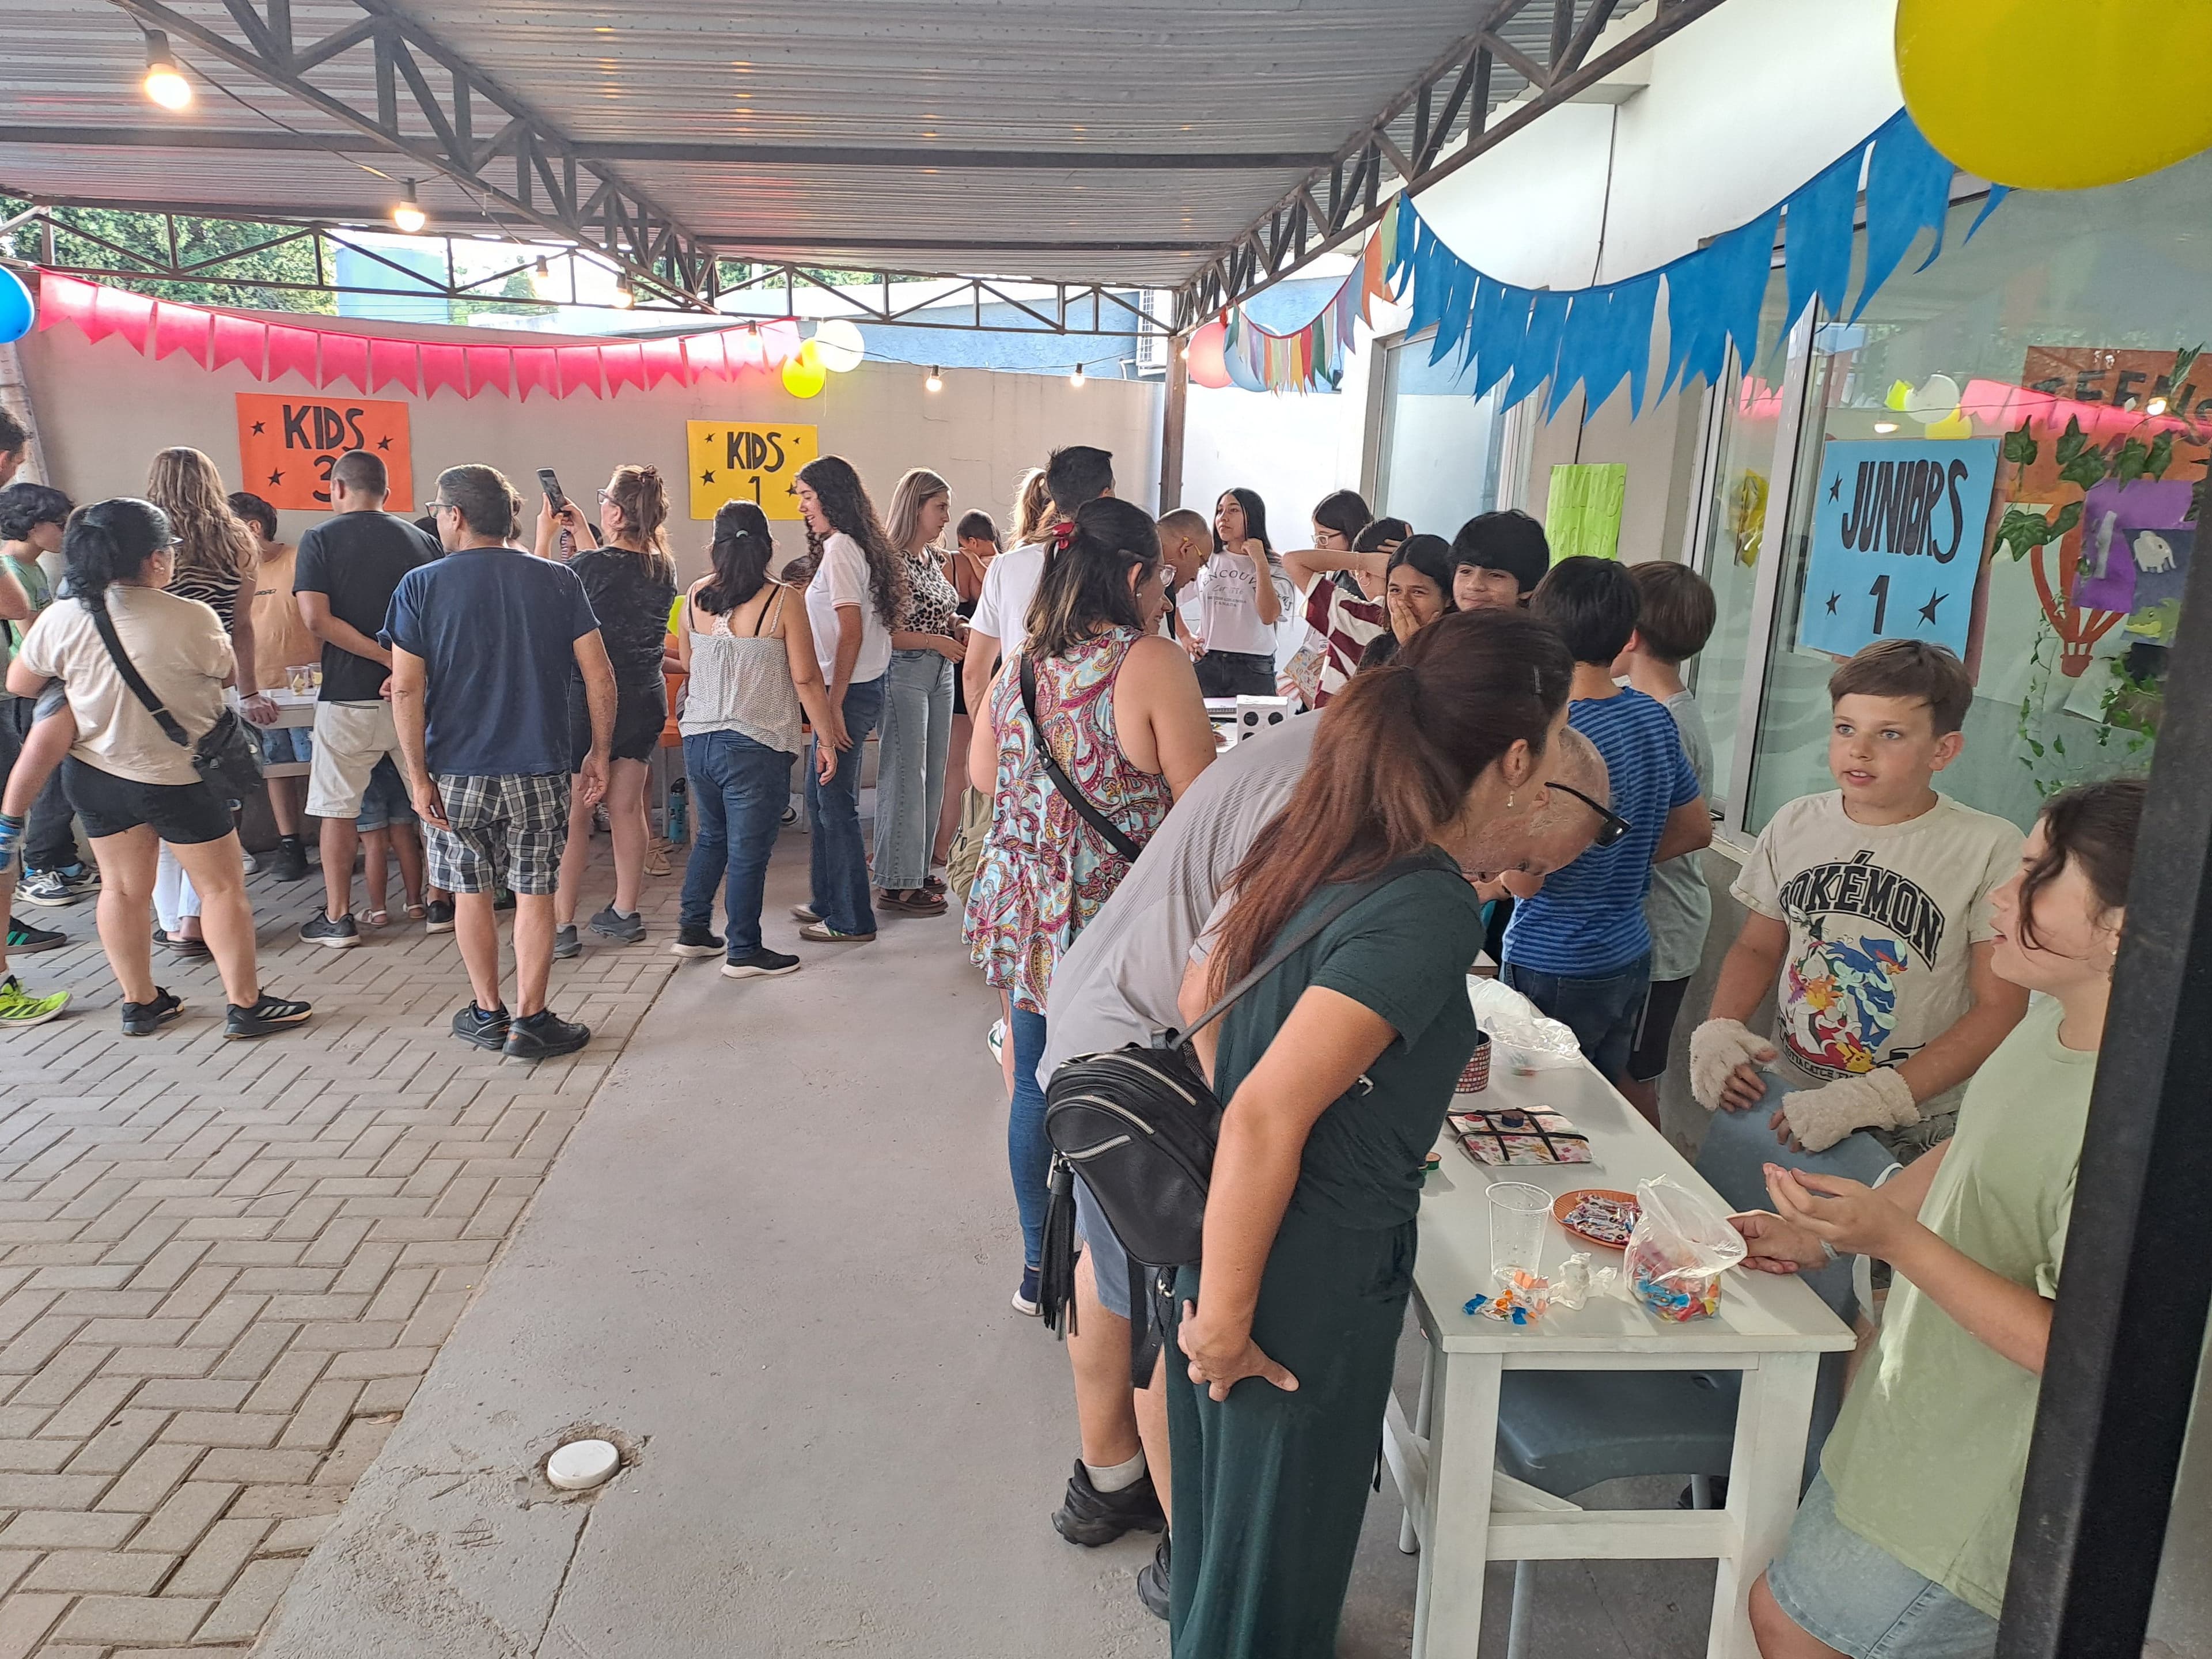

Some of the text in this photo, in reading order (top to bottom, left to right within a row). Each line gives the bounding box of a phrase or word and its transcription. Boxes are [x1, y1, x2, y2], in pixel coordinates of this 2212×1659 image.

[282, 404, 365, 452] KIDS
[726, 431, 785, 473] KIDS
[748, 476, 760, 505] 1
[1842, 459, 1969, 564] JUNIORS
[1868, 574, 1890, 635] 1
